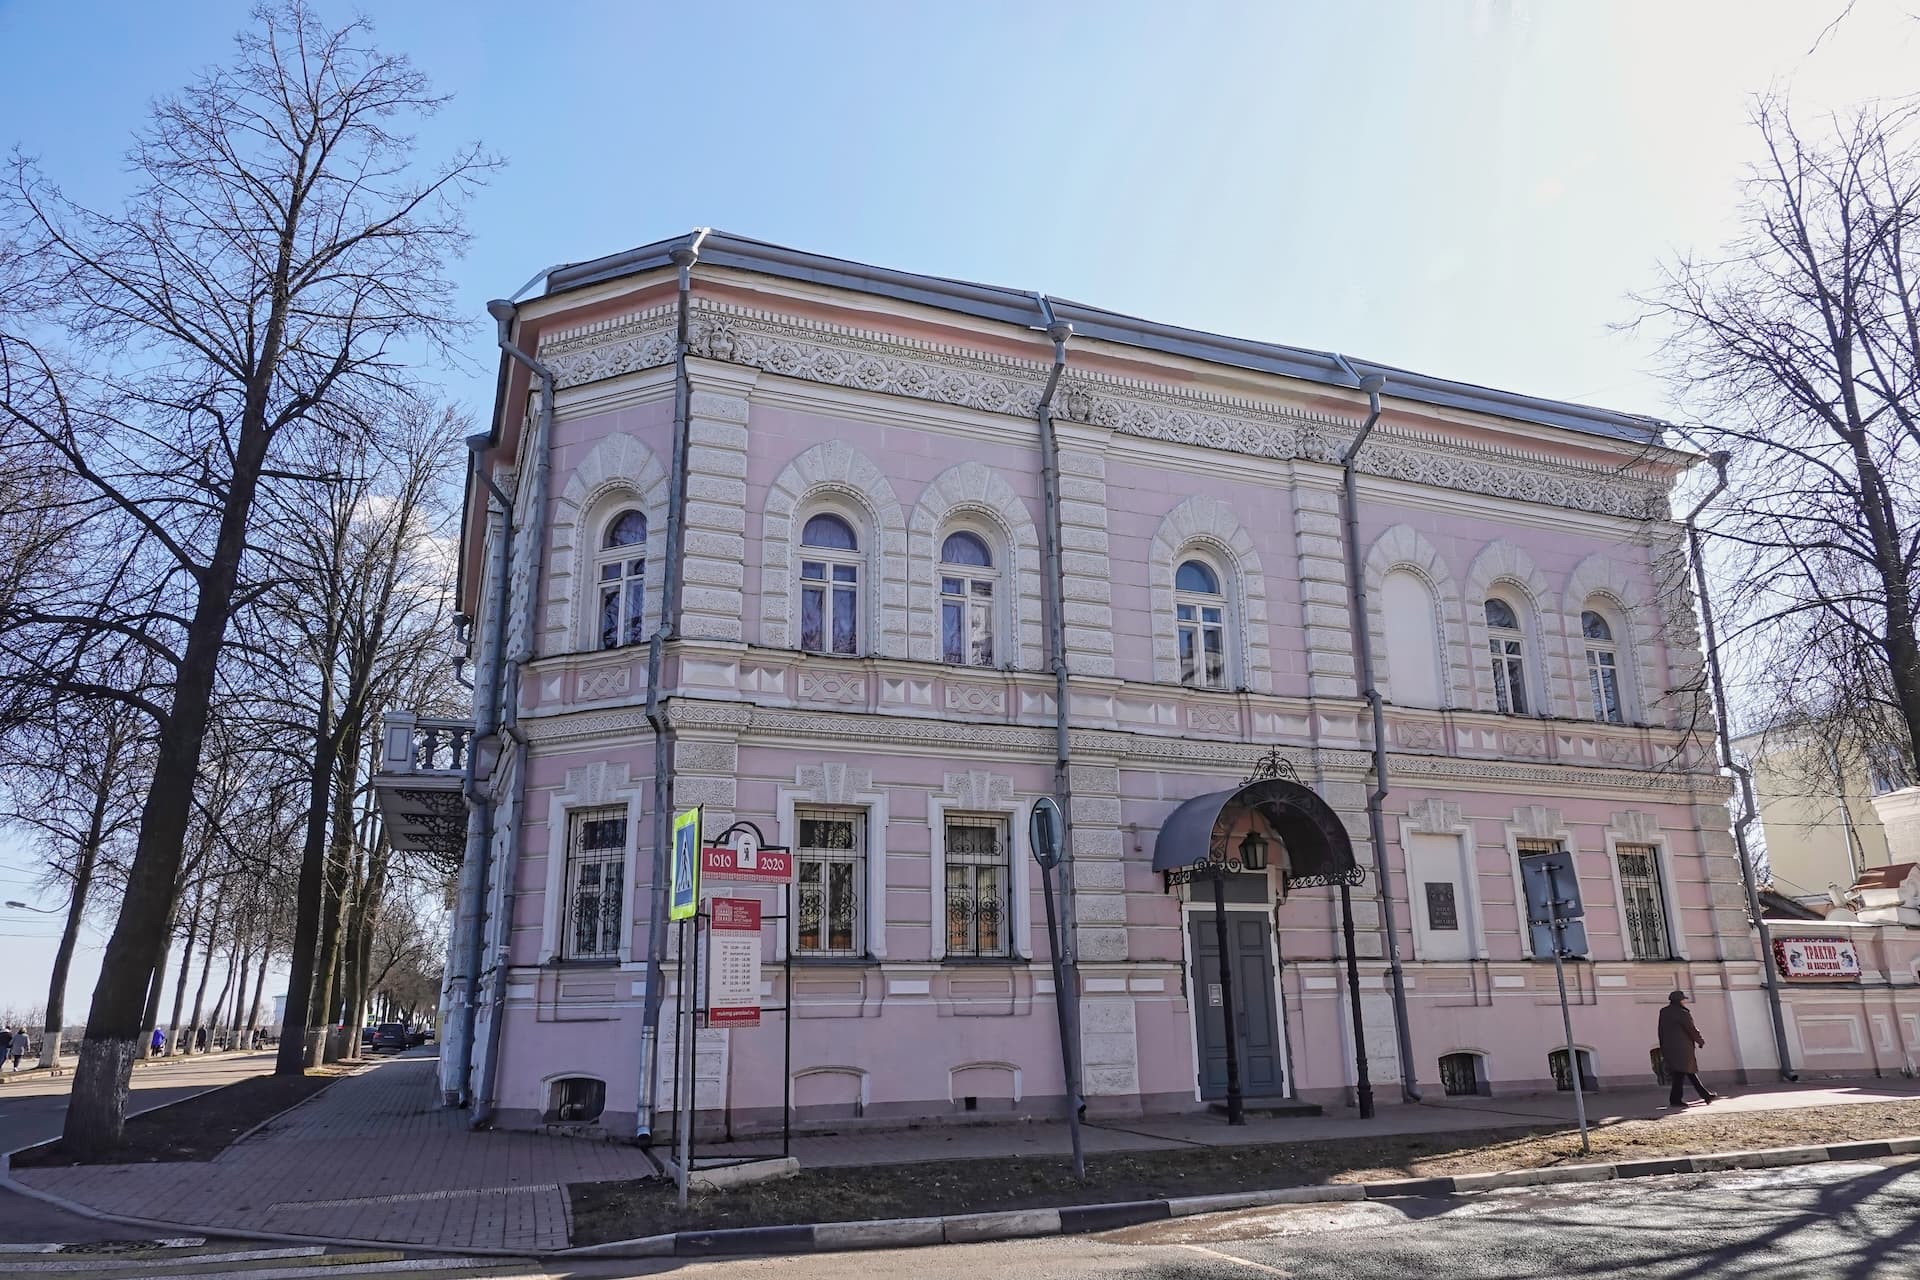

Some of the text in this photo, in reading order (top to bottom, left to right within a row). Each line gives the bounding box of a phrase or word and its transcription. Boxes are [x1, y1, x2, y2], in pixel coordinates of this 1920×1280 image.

[708, 853, 784, 871] 1010 2020
[1804, 945, 1837, 960] ТРАКТИР
